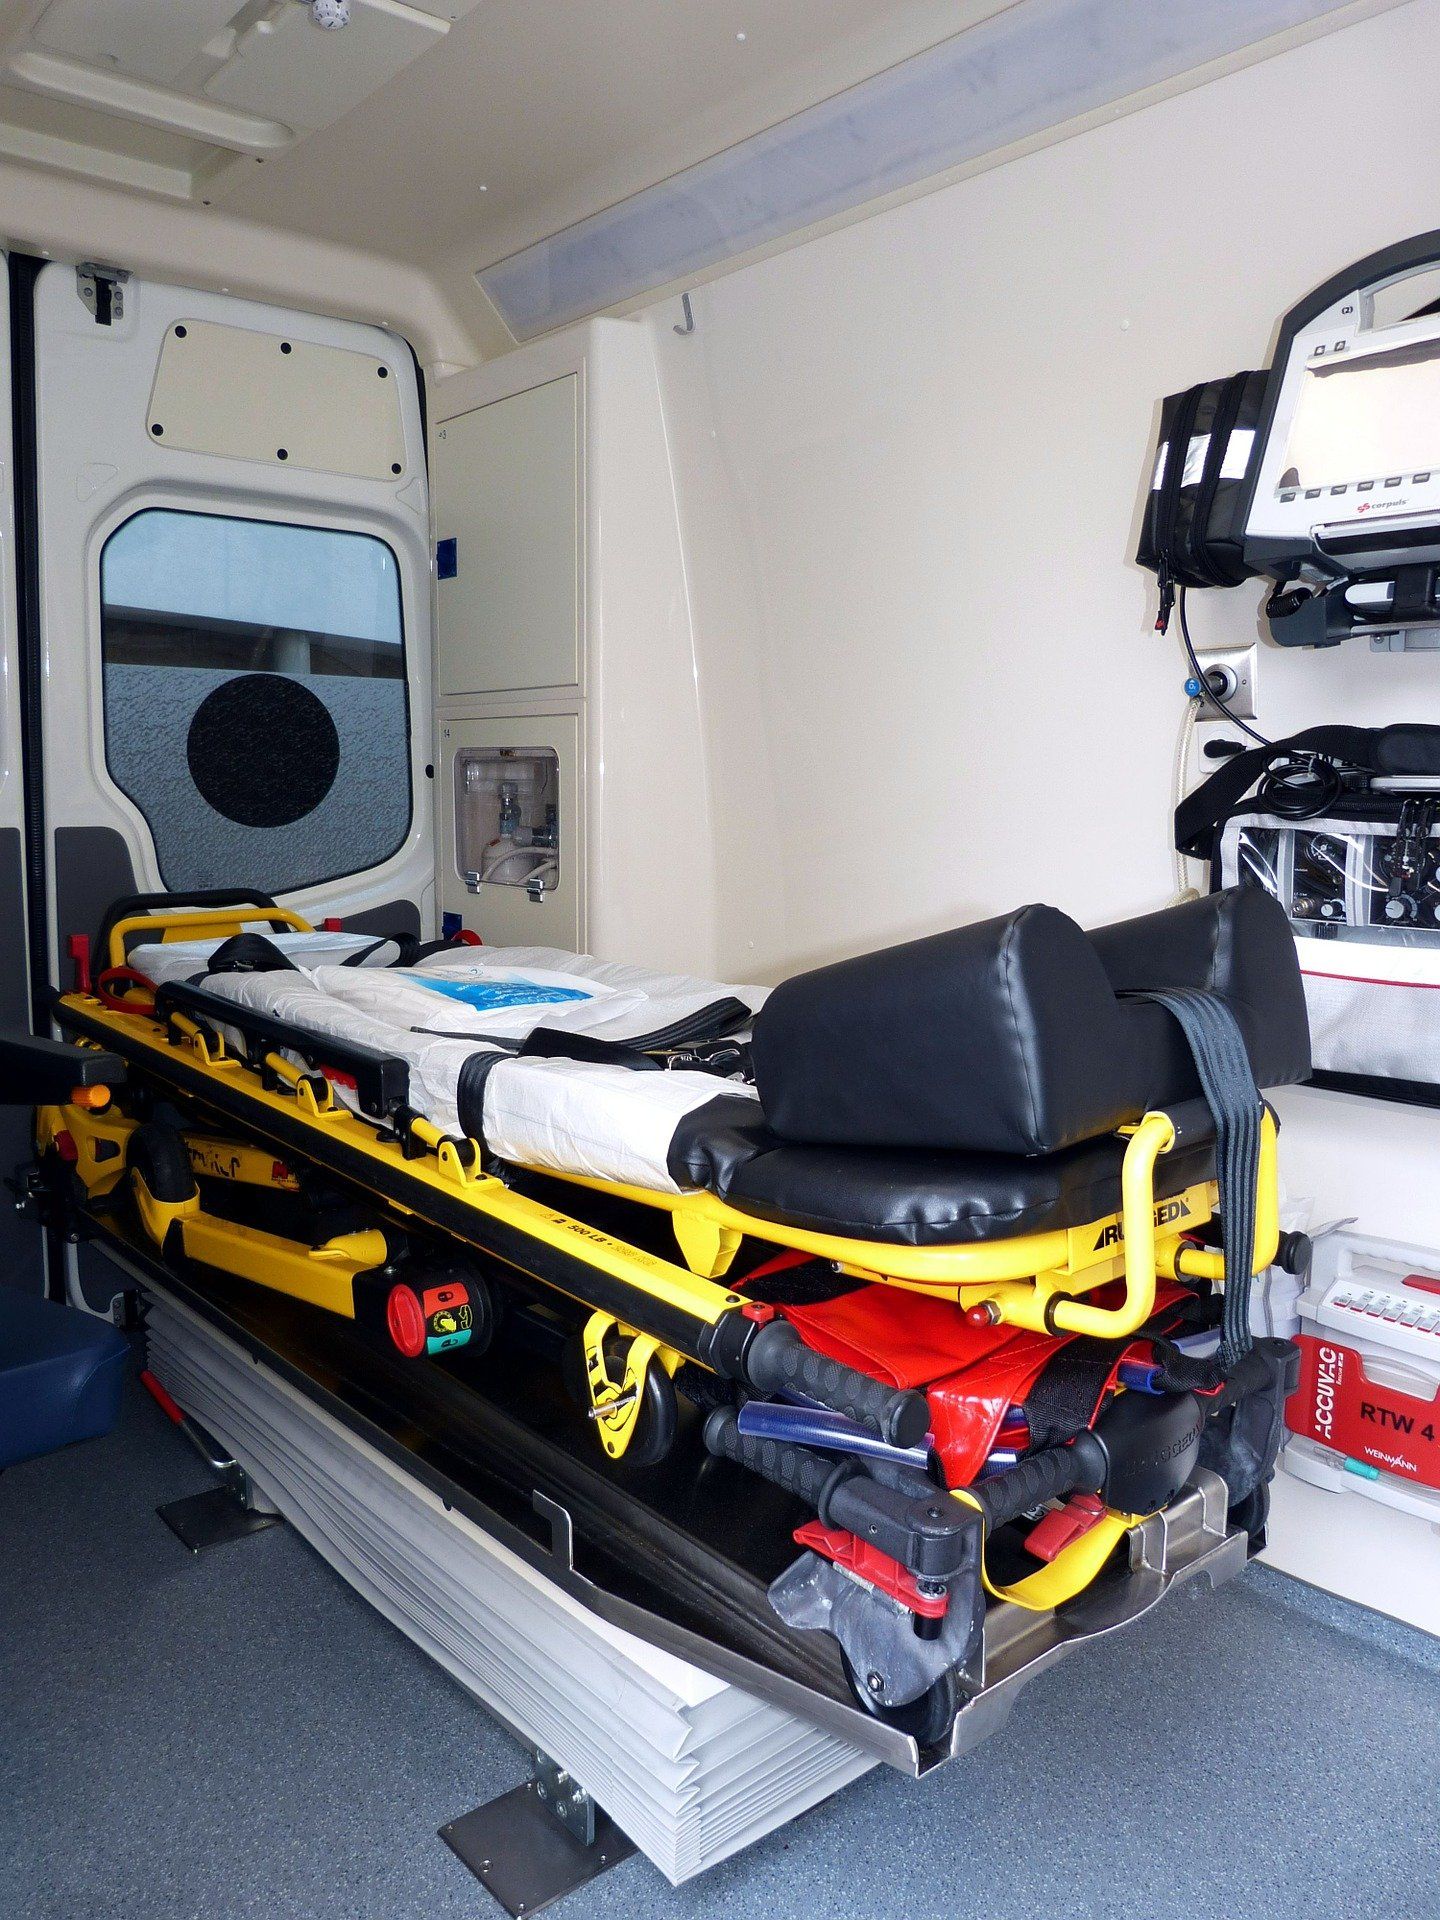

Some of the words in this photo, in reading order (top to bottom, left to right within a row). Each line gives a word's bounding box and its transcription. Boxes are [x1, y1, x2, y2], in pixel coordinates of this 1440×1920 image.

[1341, 306, 1354, 314] (2)
[1371, 499, 1408, 509] corpuls
[567, 1224, 591, 1236] 500
[588, 1234, 607, 1243] LB
[1104, 1202, 1181, 1247] RUED
[1315, 1346, 1337, 1440] ACCUVAC
[1360, 1401, 1415, 1434] RTW
[1420, 1423, 1435, 1442] 4
[1363, 1446, 1418, 1472] WEINMANN
